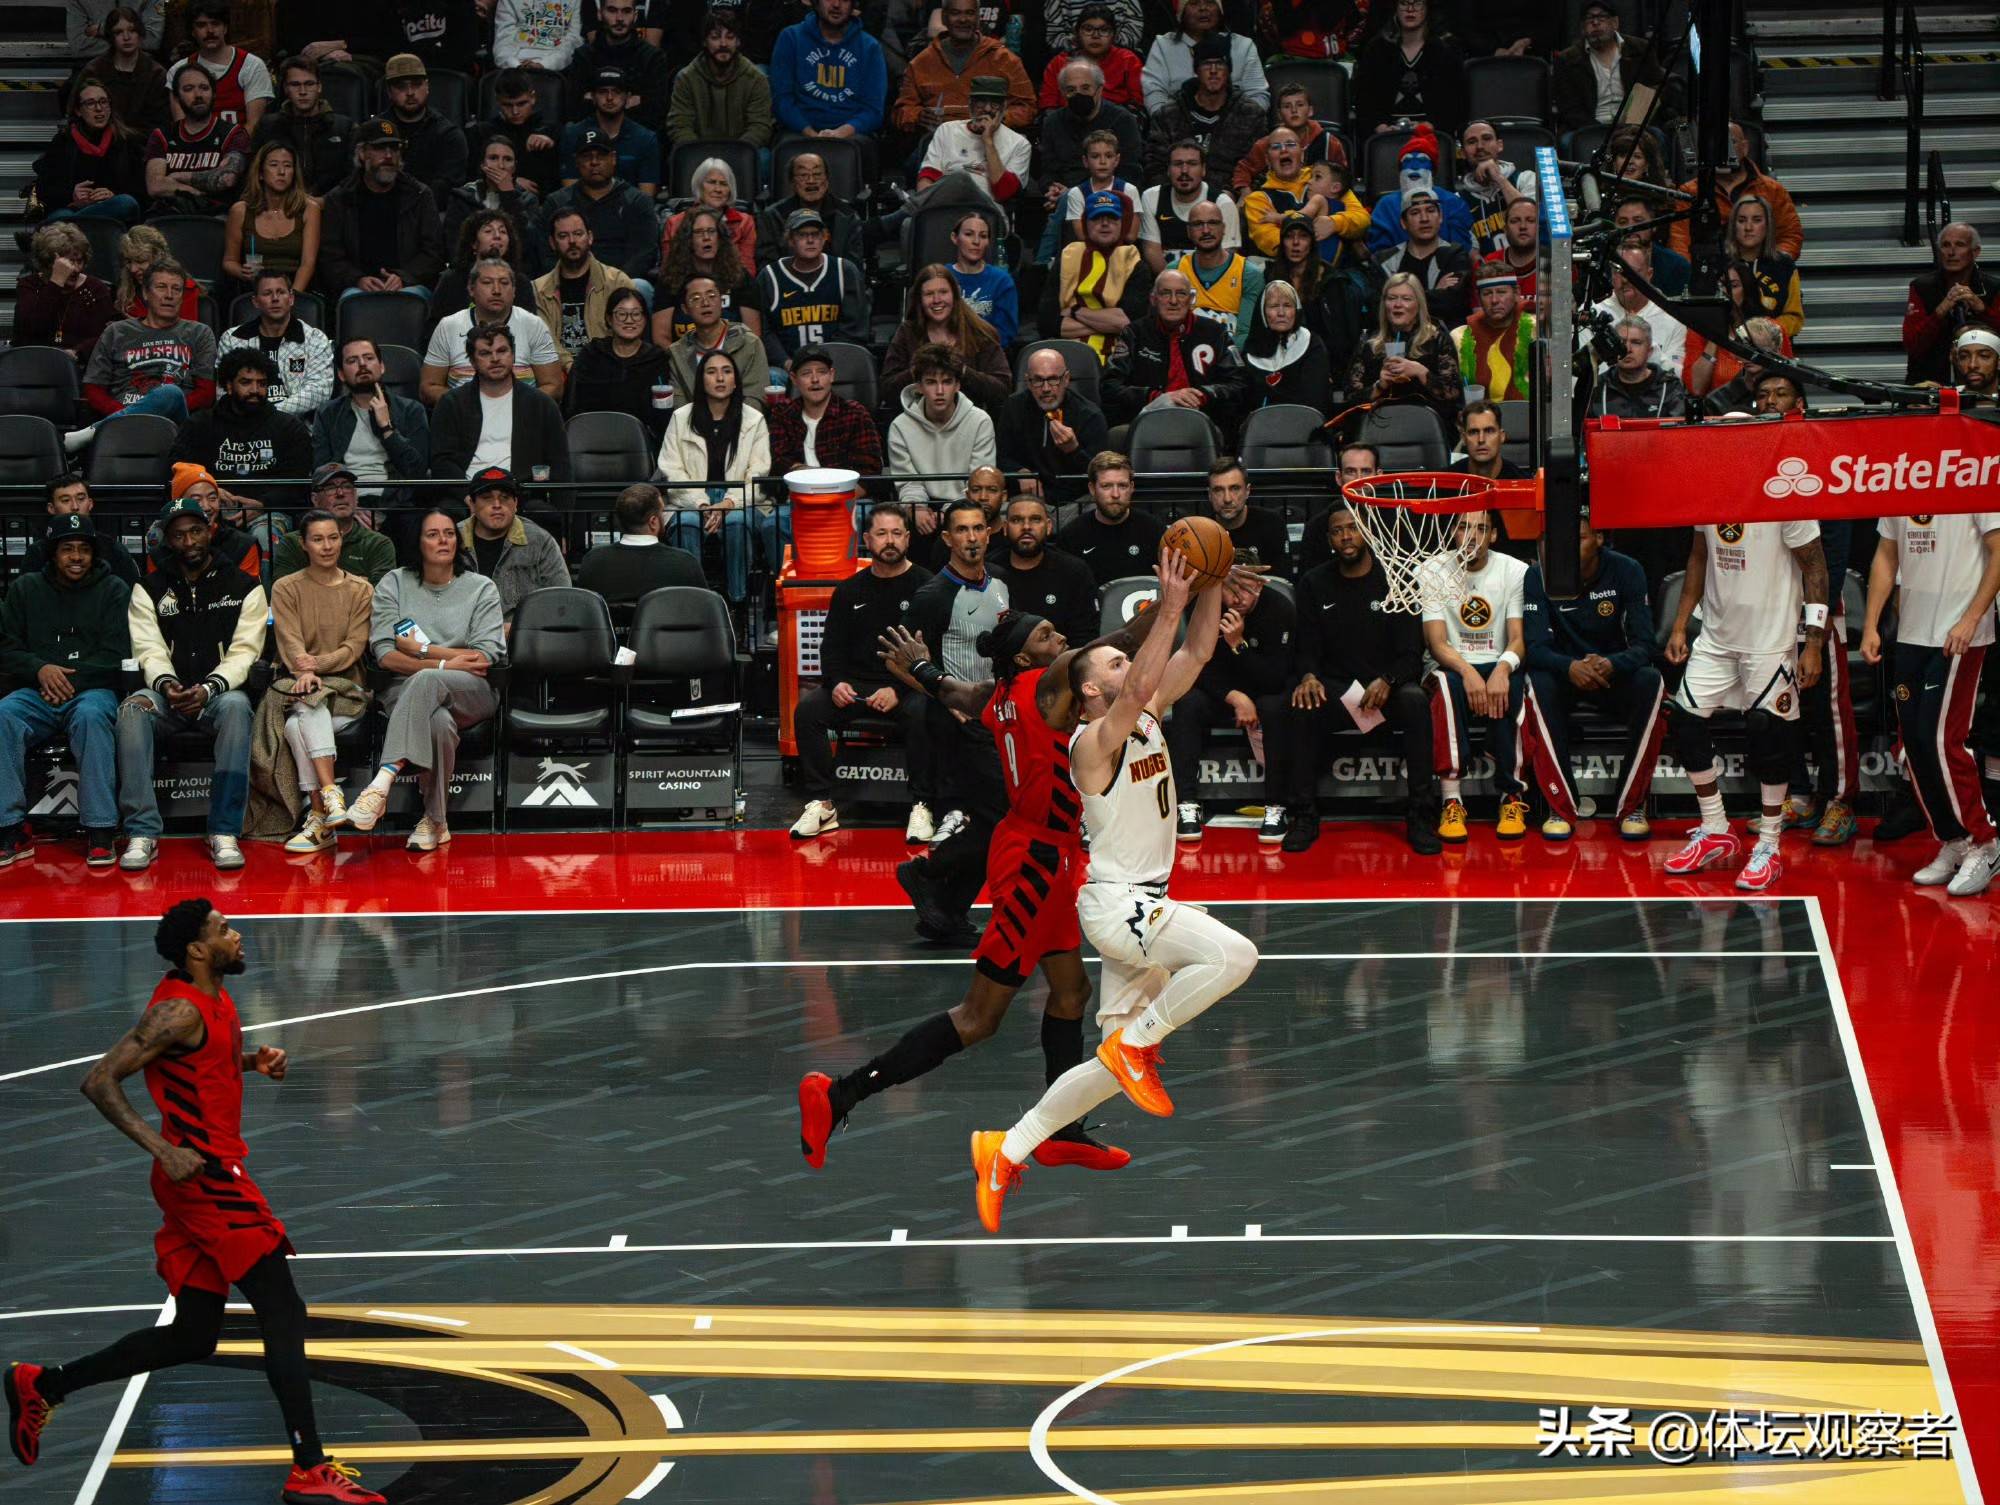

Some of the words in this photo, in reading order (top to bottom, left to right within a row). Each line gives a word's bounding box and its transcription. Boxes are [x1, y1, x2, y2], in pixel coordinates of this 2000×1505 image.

[165, 151, 222, 171] PORTLAND
[780, 304, 841, 327] DENVER
[798, 324, 824, 347] 15
[221, 437, 245, 452] Are
[247, 439, 273, 453] you
[219, 446, 260, 464] happy
[214, 460, 235, 471] for
[1828, 453, 1933, 495] State
[1935, 449, 2000, 488] Far
[70, 515, 80, 529] S
[1589, 589, 1617, 600] ibotta
[628, 769, 664, 780] SPIRIT
[666, 768, 731, 779] MOUNTAIN
[835, 765, 909, 782] GATORA
[1129, 752, 1167, 783] NUGG
[658, 781, 701, 791] CASINO
[1157, 776, 1170, 819] 0
